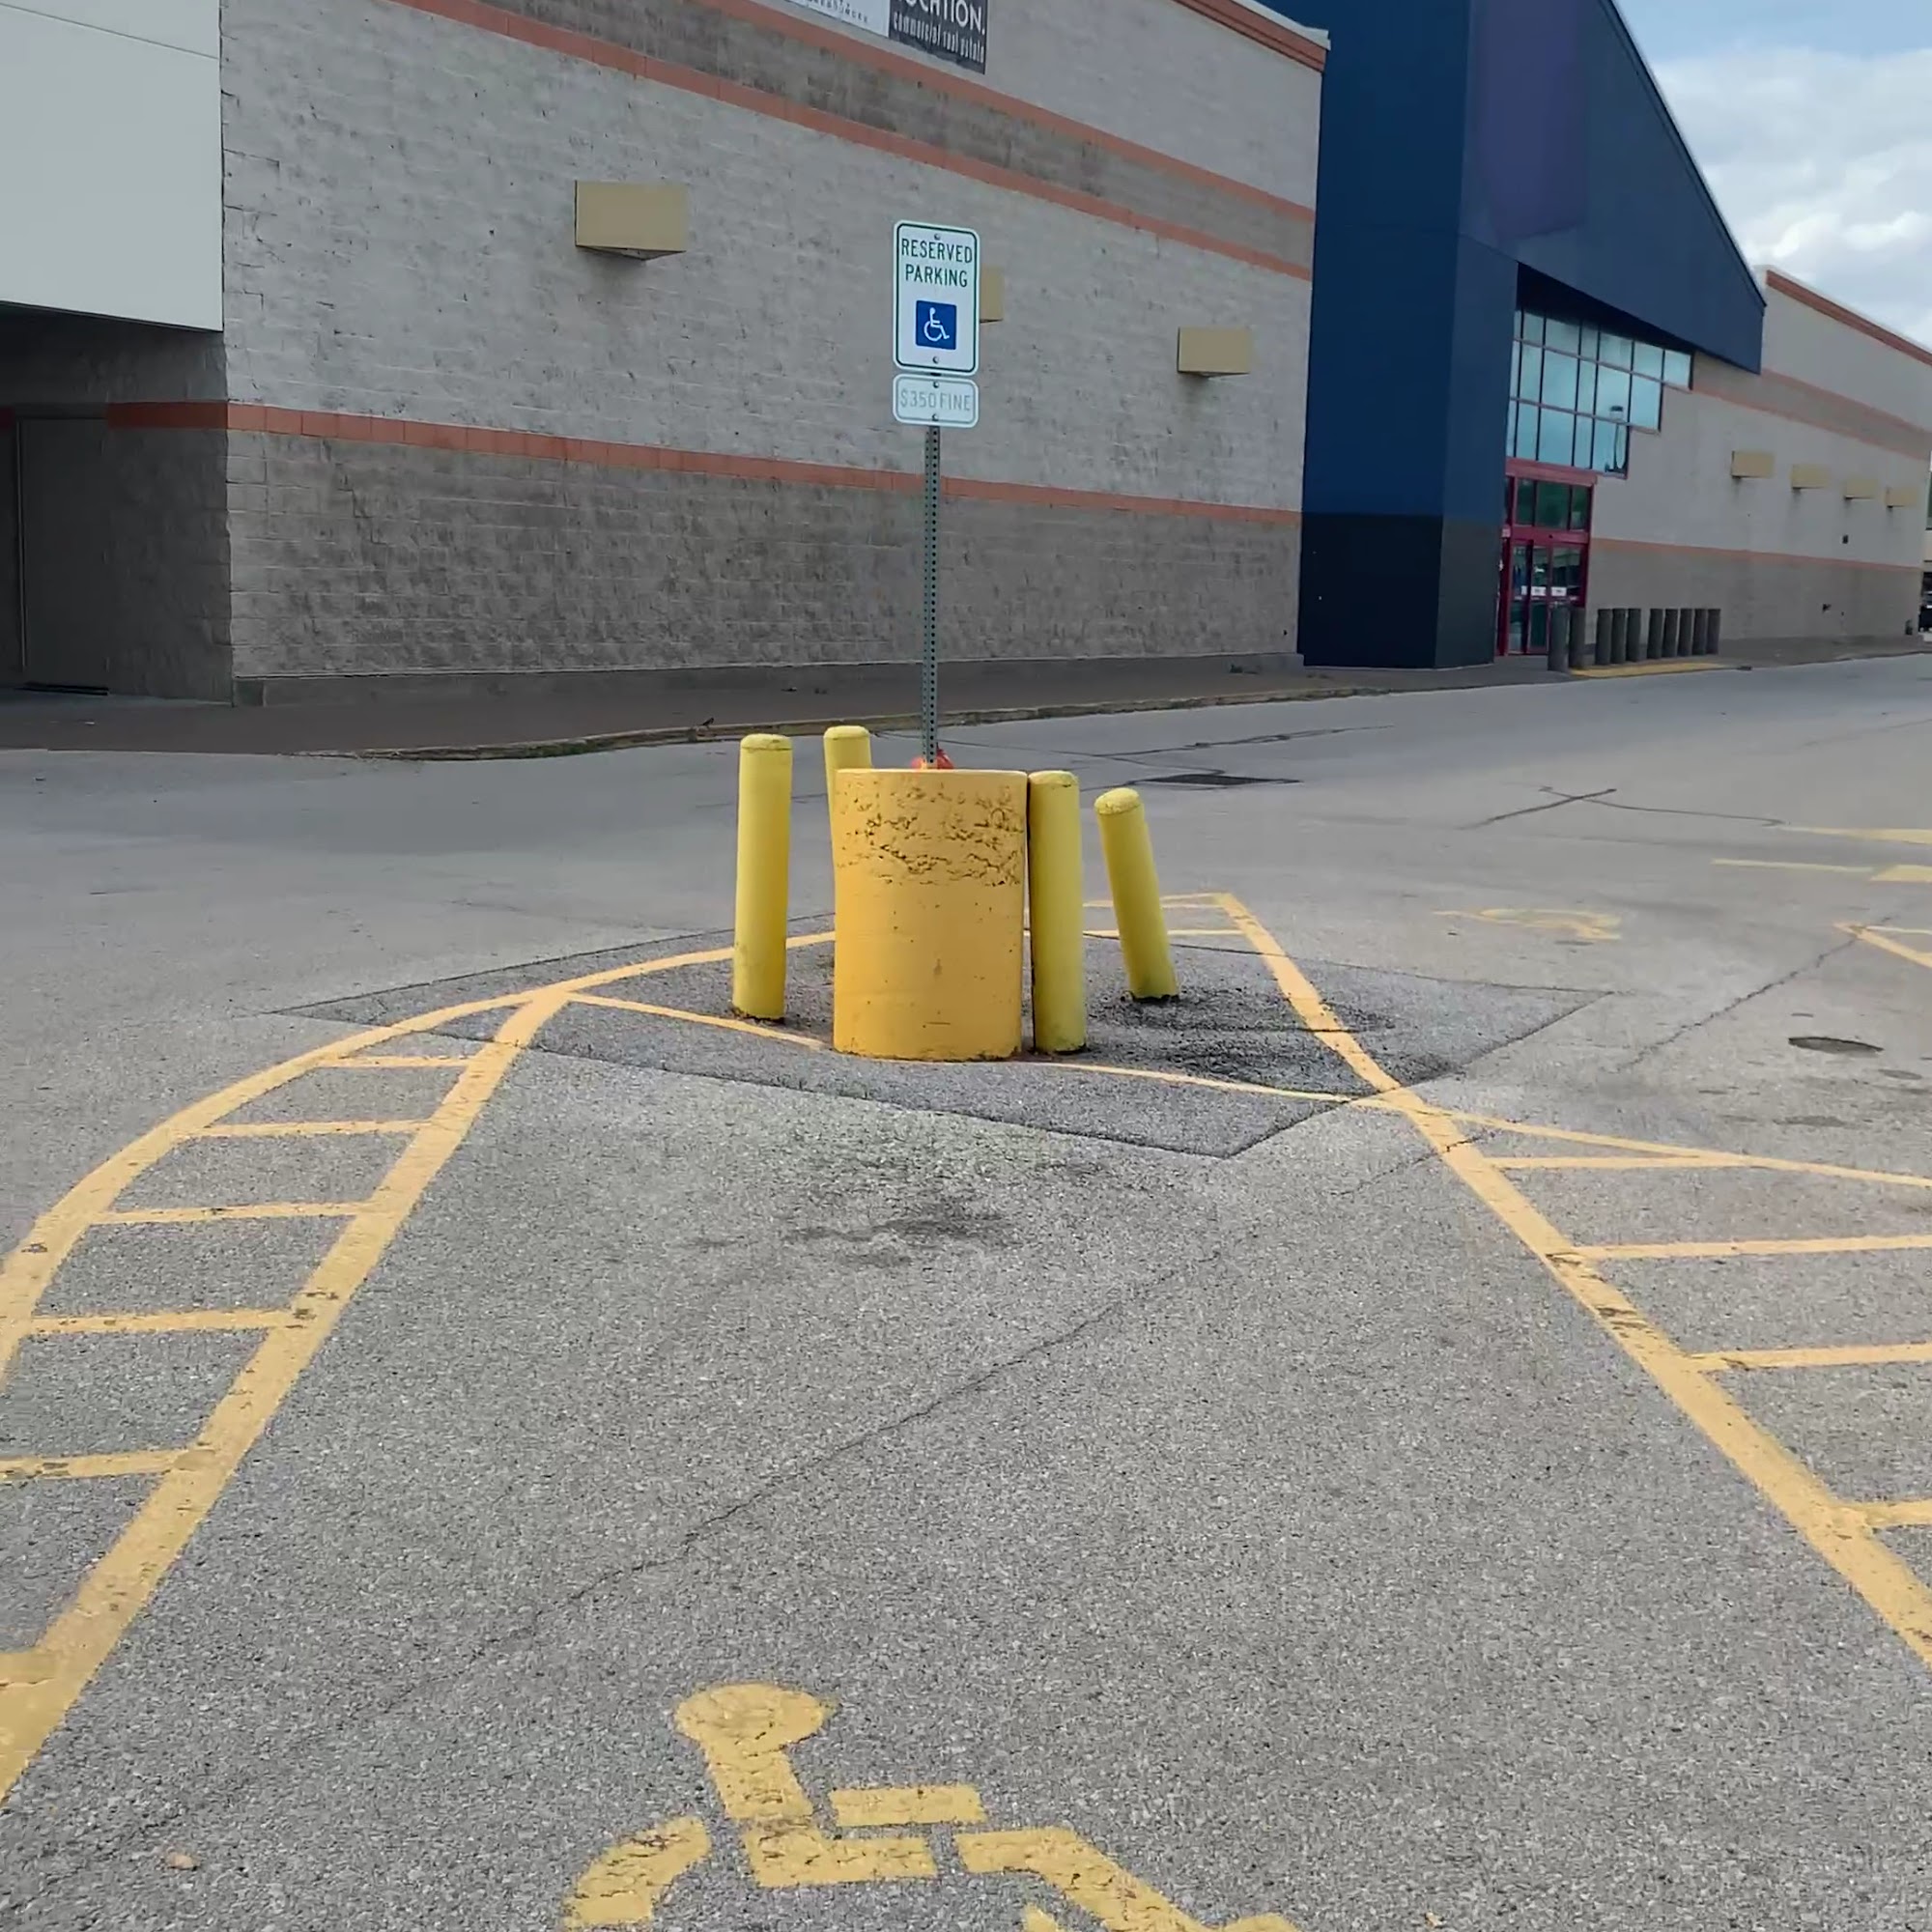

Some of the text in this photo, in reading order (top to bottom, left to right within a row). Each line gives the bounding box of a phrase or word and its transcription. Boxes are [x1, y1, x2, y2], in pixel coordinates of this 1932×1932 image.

[901, 238, 973, 264] RESERVED
[905, 264, 968, 288] PARKING
[900, 388, 971, 412] $350 FINE
